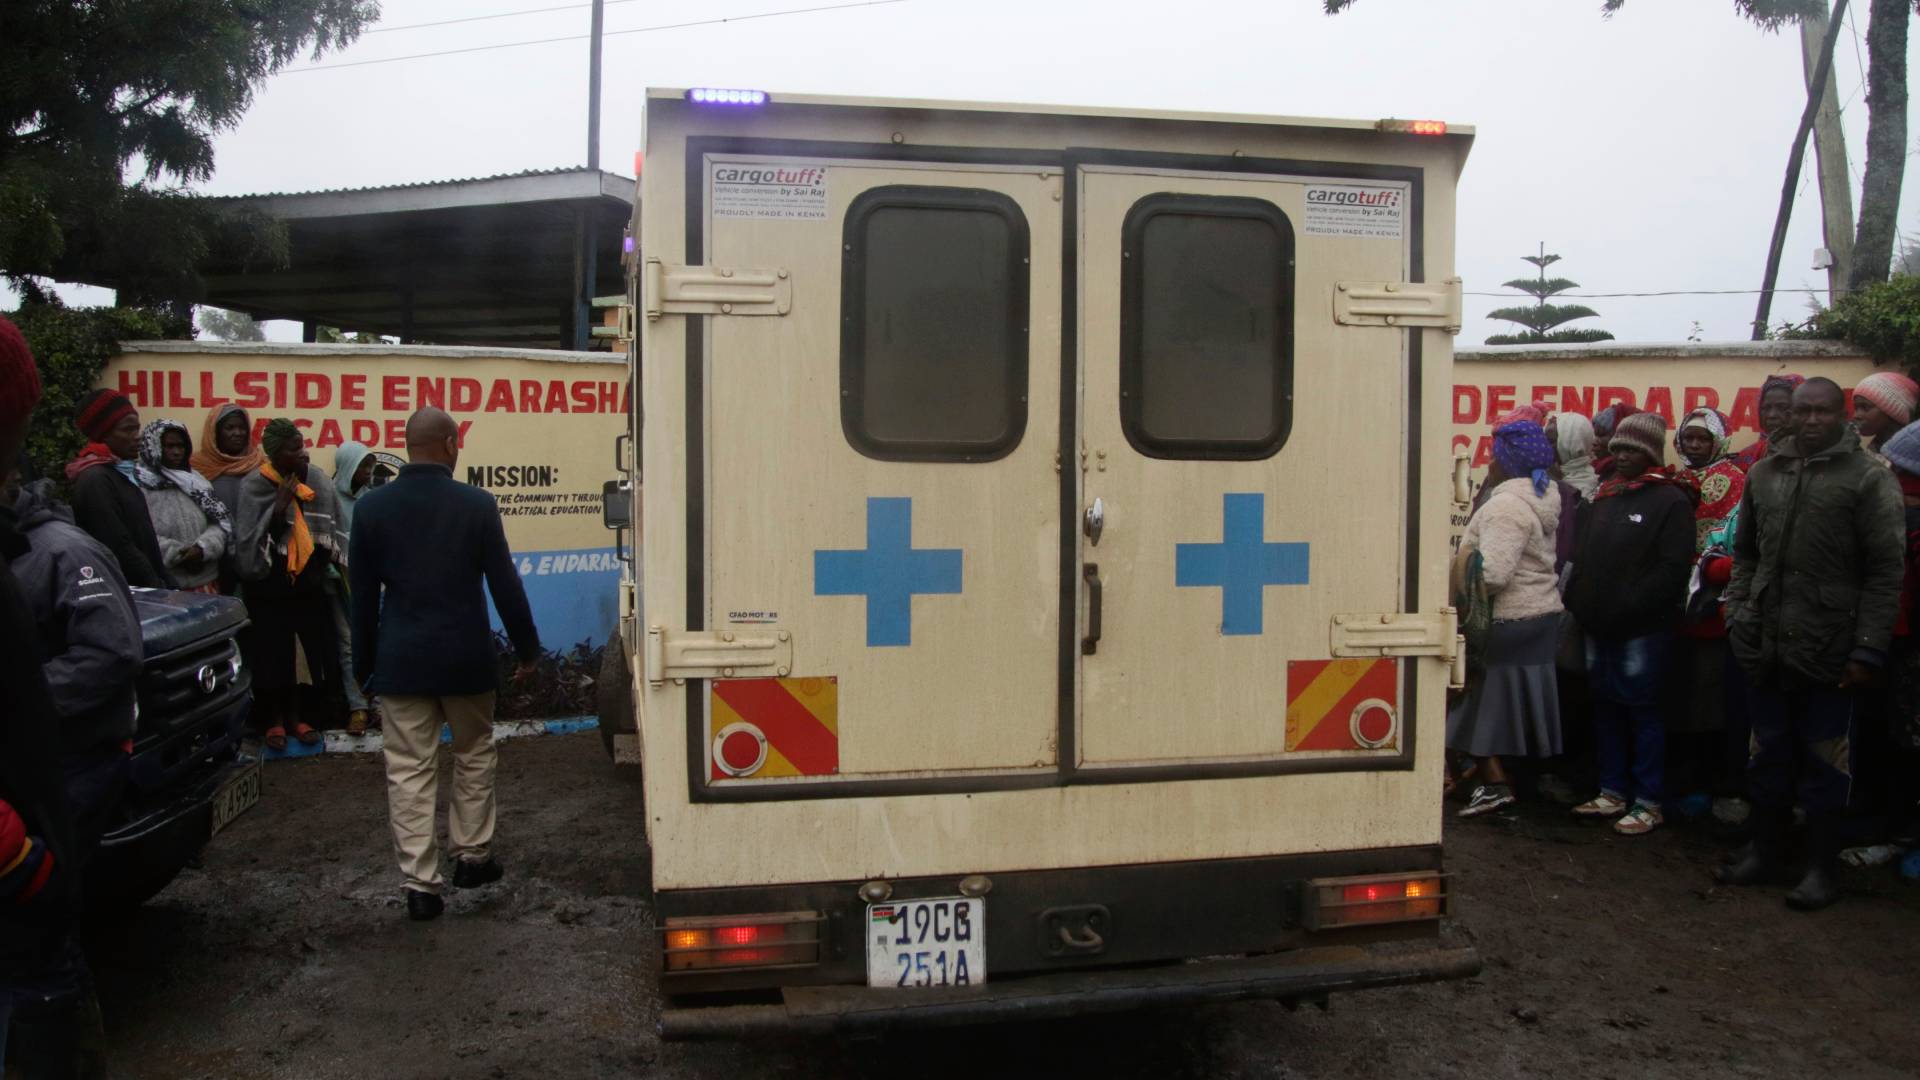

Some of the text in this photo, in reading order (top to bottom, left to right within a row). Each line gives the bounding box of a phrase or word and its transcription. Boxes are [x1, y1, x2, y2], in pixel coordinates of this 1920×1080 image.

[715, 168, 817, 184] cargotuff
[780, 188, 791, 197] by
[794, 188, 808, 196] Sai
[811, 189, 825, 197] Raj
[1306, 189, 1393, 205] cargotuff
[714, 208, 826, 218] PROUDLY MADE IN KENYA
[1362, 208, 1371, 217] by
[1387, 210, 1400, 218] Raj
[118, 370, 367, 411] HILLSIDE
[252, 418, 473, 449] ACADEY
[467, 465, 559, 488] MISSION:
[495, 493, 513, 504] THE
[514, 493, 569, 504] COMMUNITY
[499, 505, 602, 516] PRACTICAL EDUCATION
[895, 902, 971, 945] 19CG
[897, 949, 970, 987] 251A
